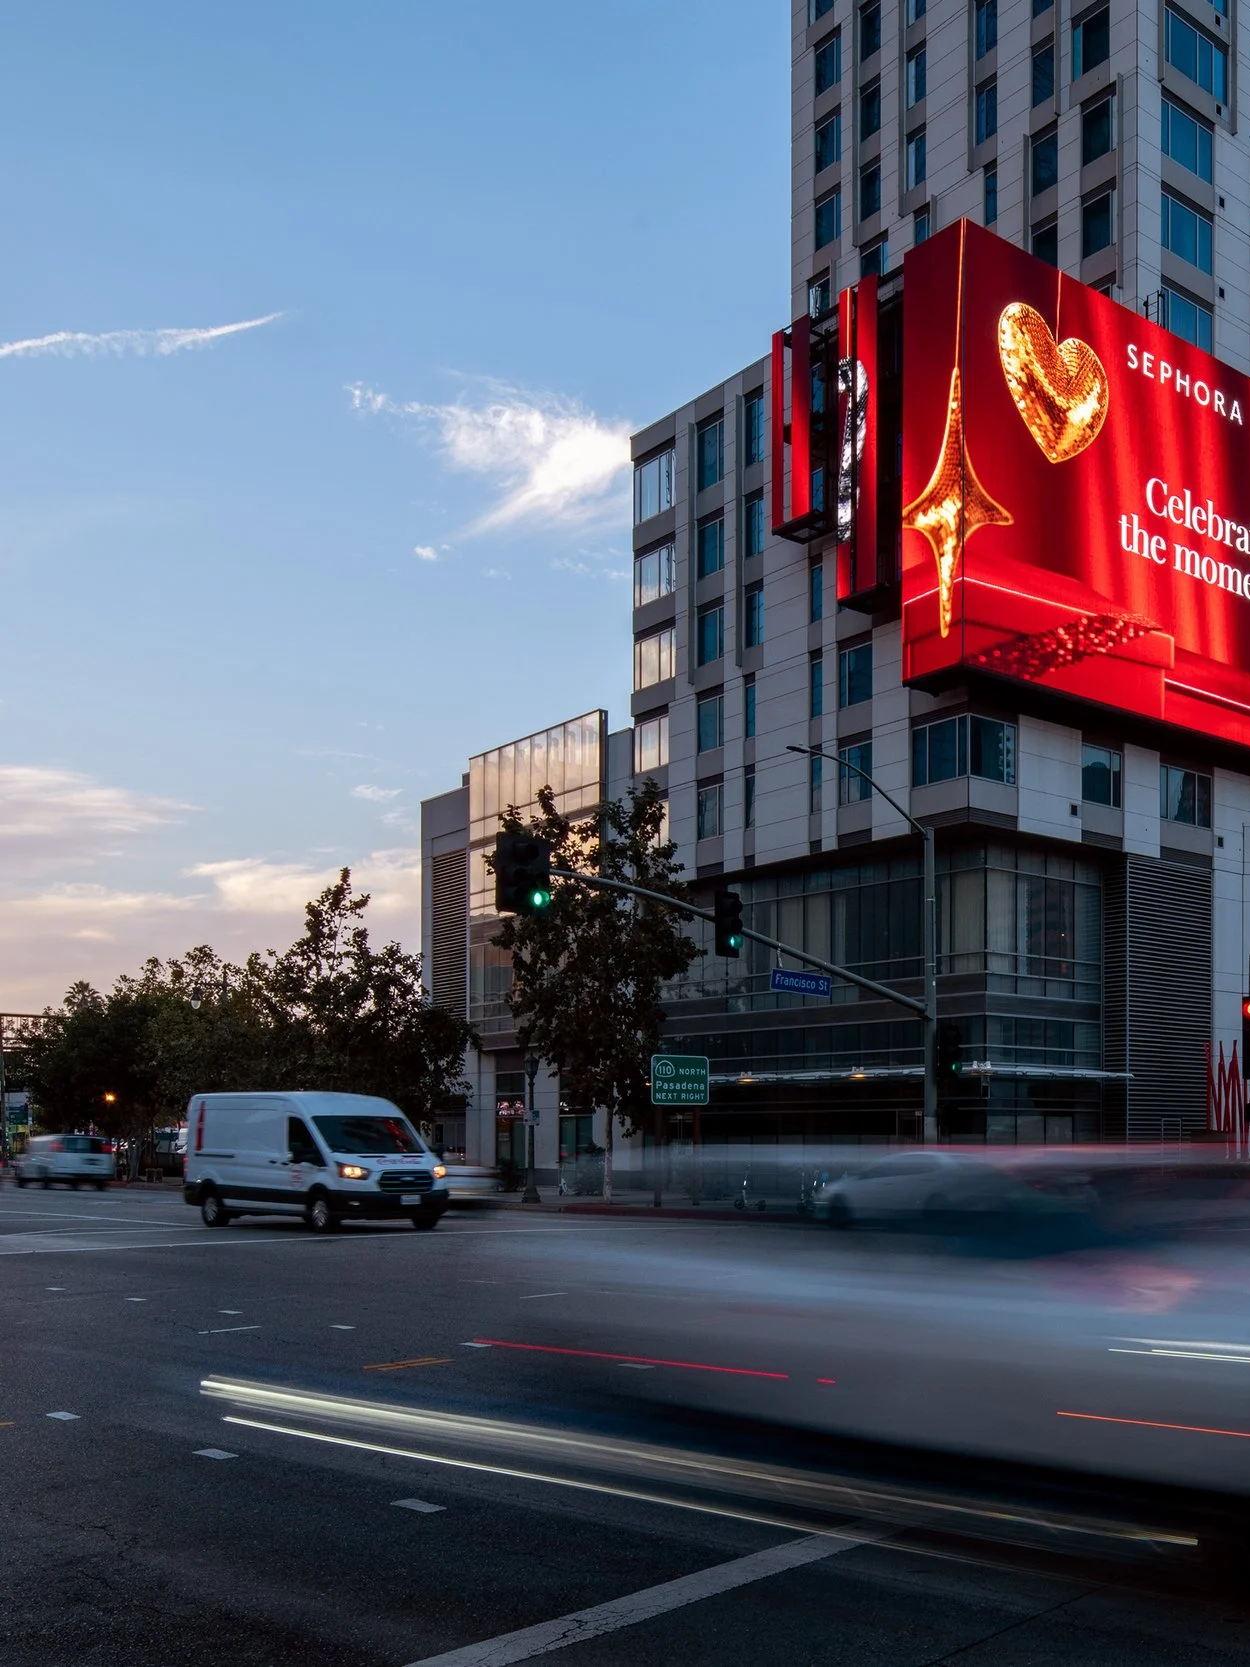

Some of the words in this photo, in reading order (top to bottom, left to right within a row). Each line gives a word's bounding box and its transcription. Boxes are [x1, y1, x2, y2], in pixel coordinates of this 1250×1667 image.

[1126, 343, 1244, 426] SEPHORA
[1118, 512, 1167, 565] the
[775, 973, 816, 990] Francisco
[818, 980, 828, 991] St
[659, 1065, 672, 1075] 110
[679, 1068, 706, 1076] NORTH
[655, 1081, 705, 1090] Pasadena
[655, 1092, 677, 1100] NEXT
